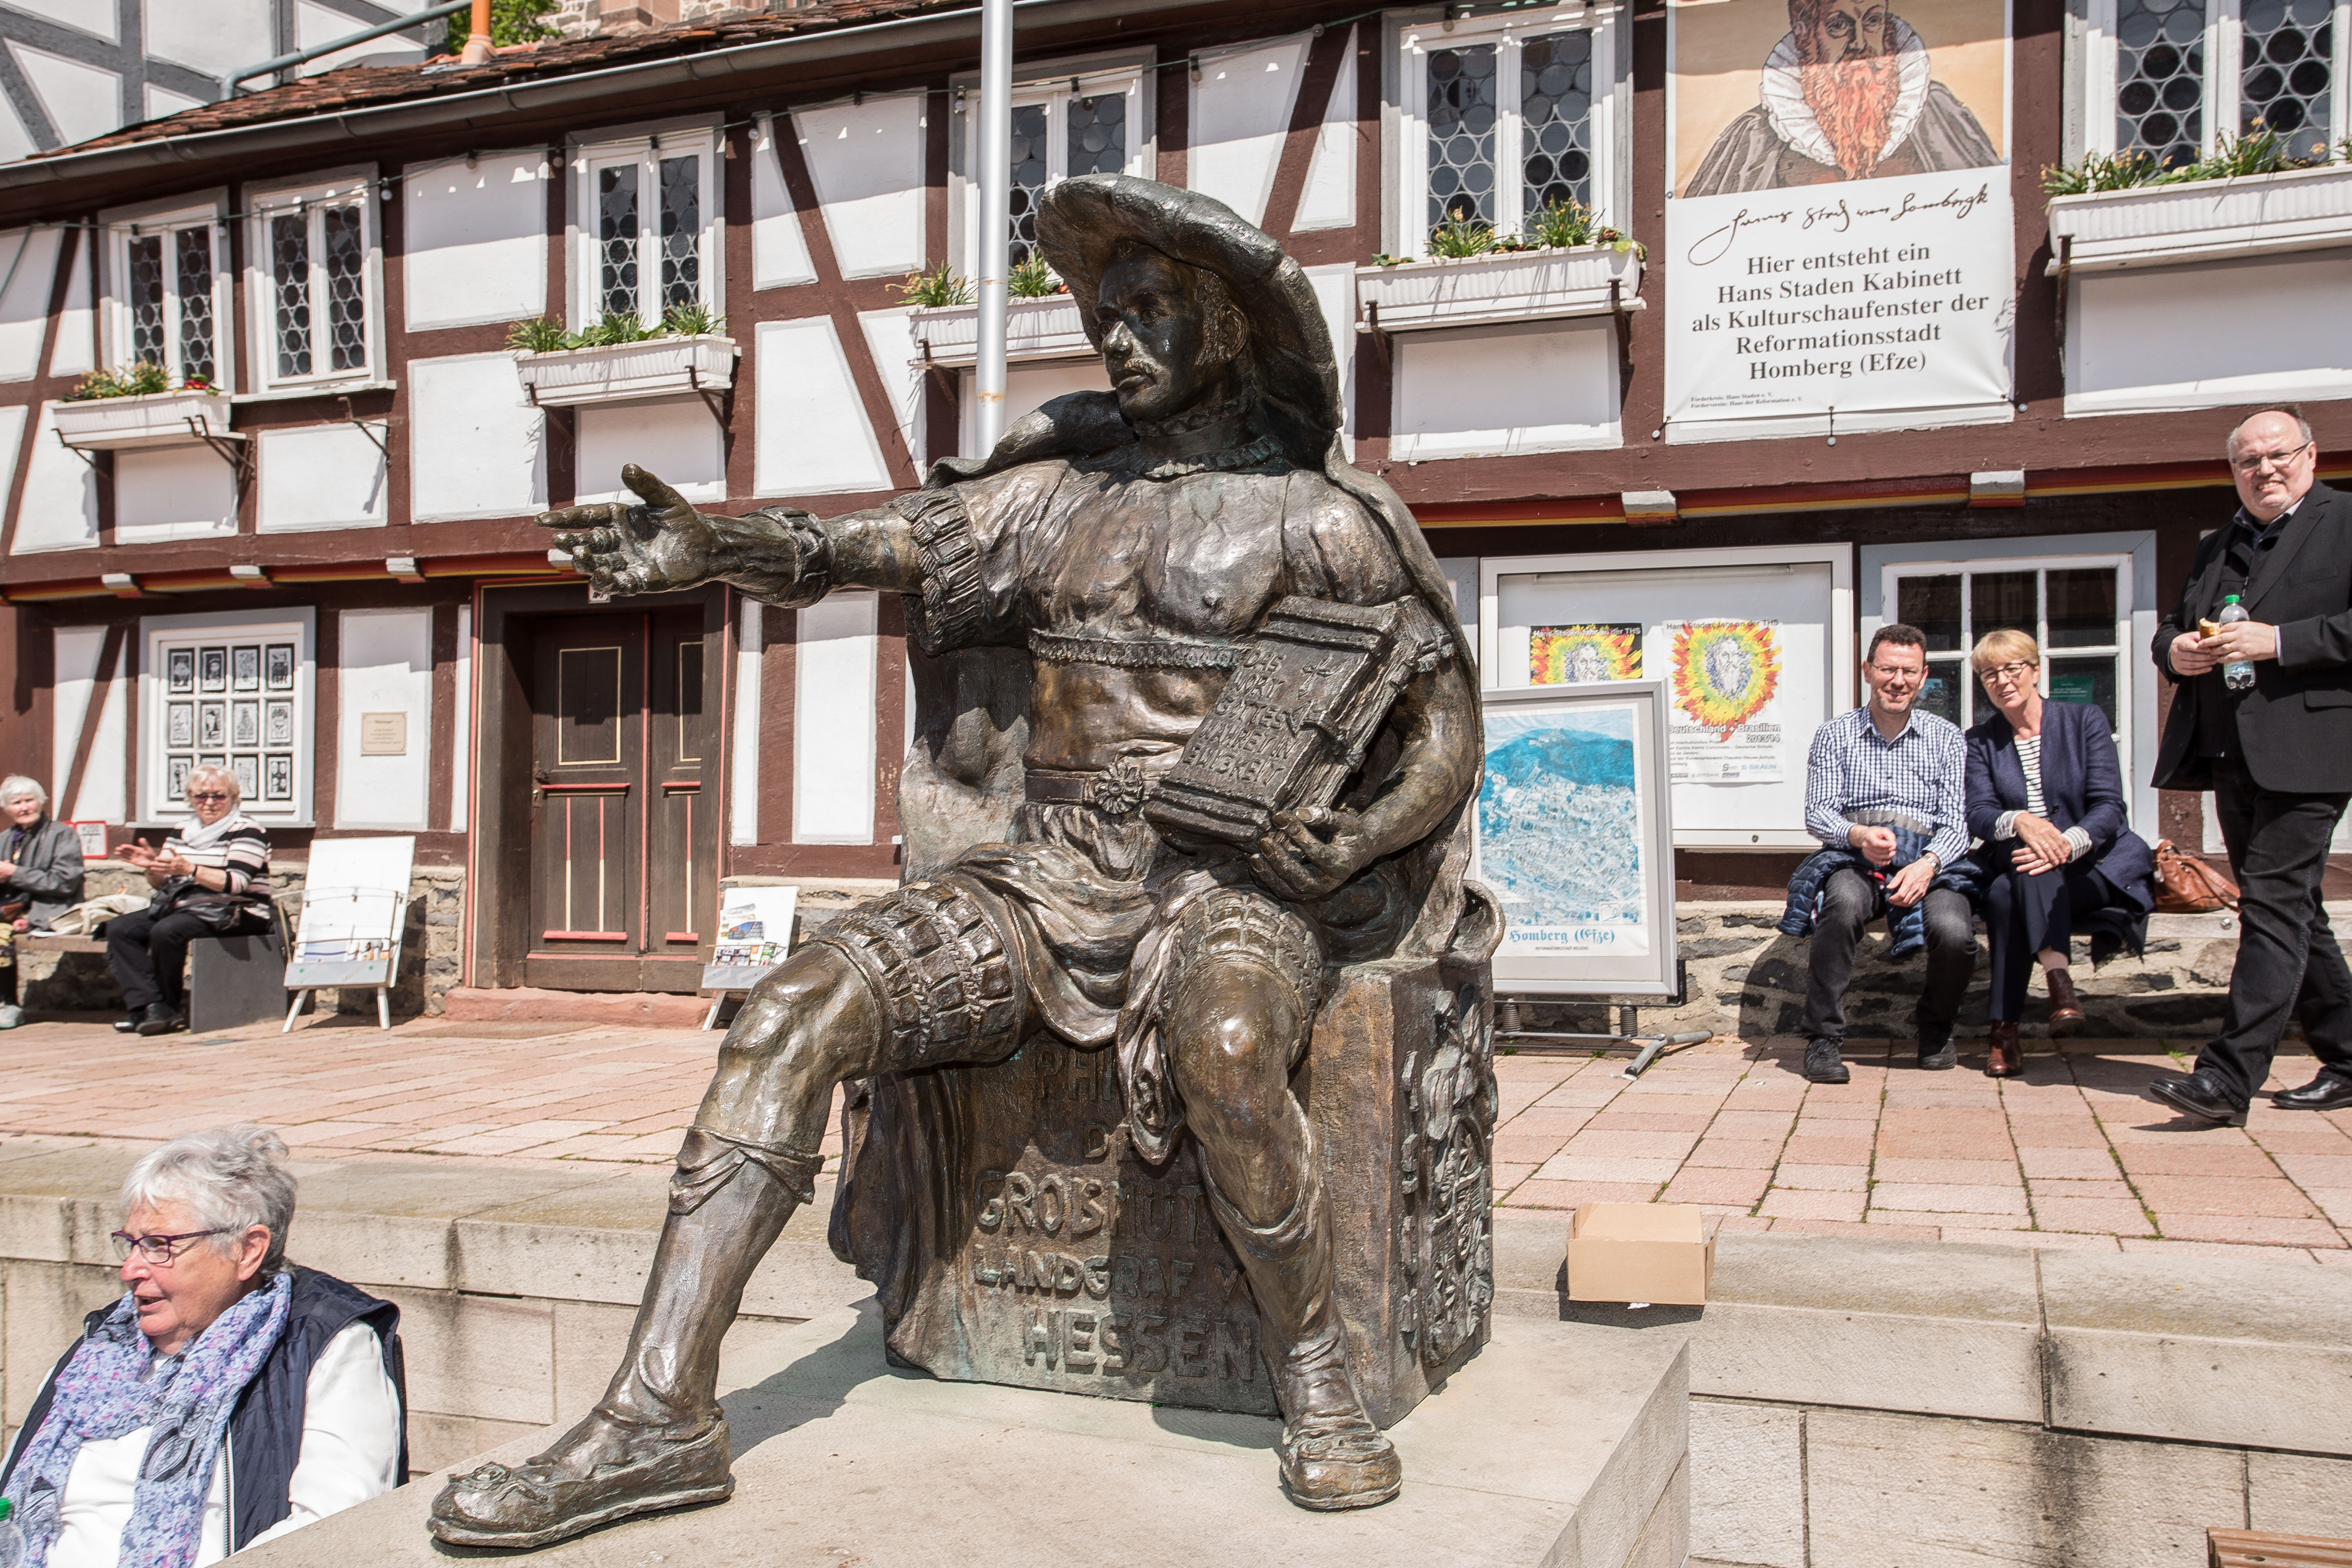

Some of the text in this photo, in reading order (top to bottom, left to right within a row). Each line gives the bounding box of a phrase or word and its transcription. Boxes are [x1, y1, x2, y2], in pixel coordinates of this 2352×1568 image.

[1748, 243, 1930, 275] Hier entsteht ein
[1718, 268, 1962, 304] Hans Staden Kabinett
[1692, 294, 1989, 332] als Kulturschaufenster der
[1736, 323, 1941, 354] Reformationsstadt
[1750, 351, 1926, 380] Homberg (Efze)
[1737, 723, 1781, 733] Brasilien
[1509, 928, 1615, 944] Homberg (Efze)
[974, 1244, 1195, 1299] LANDGRAF
[1022, 1307, 1254, 1381] HESSEN
